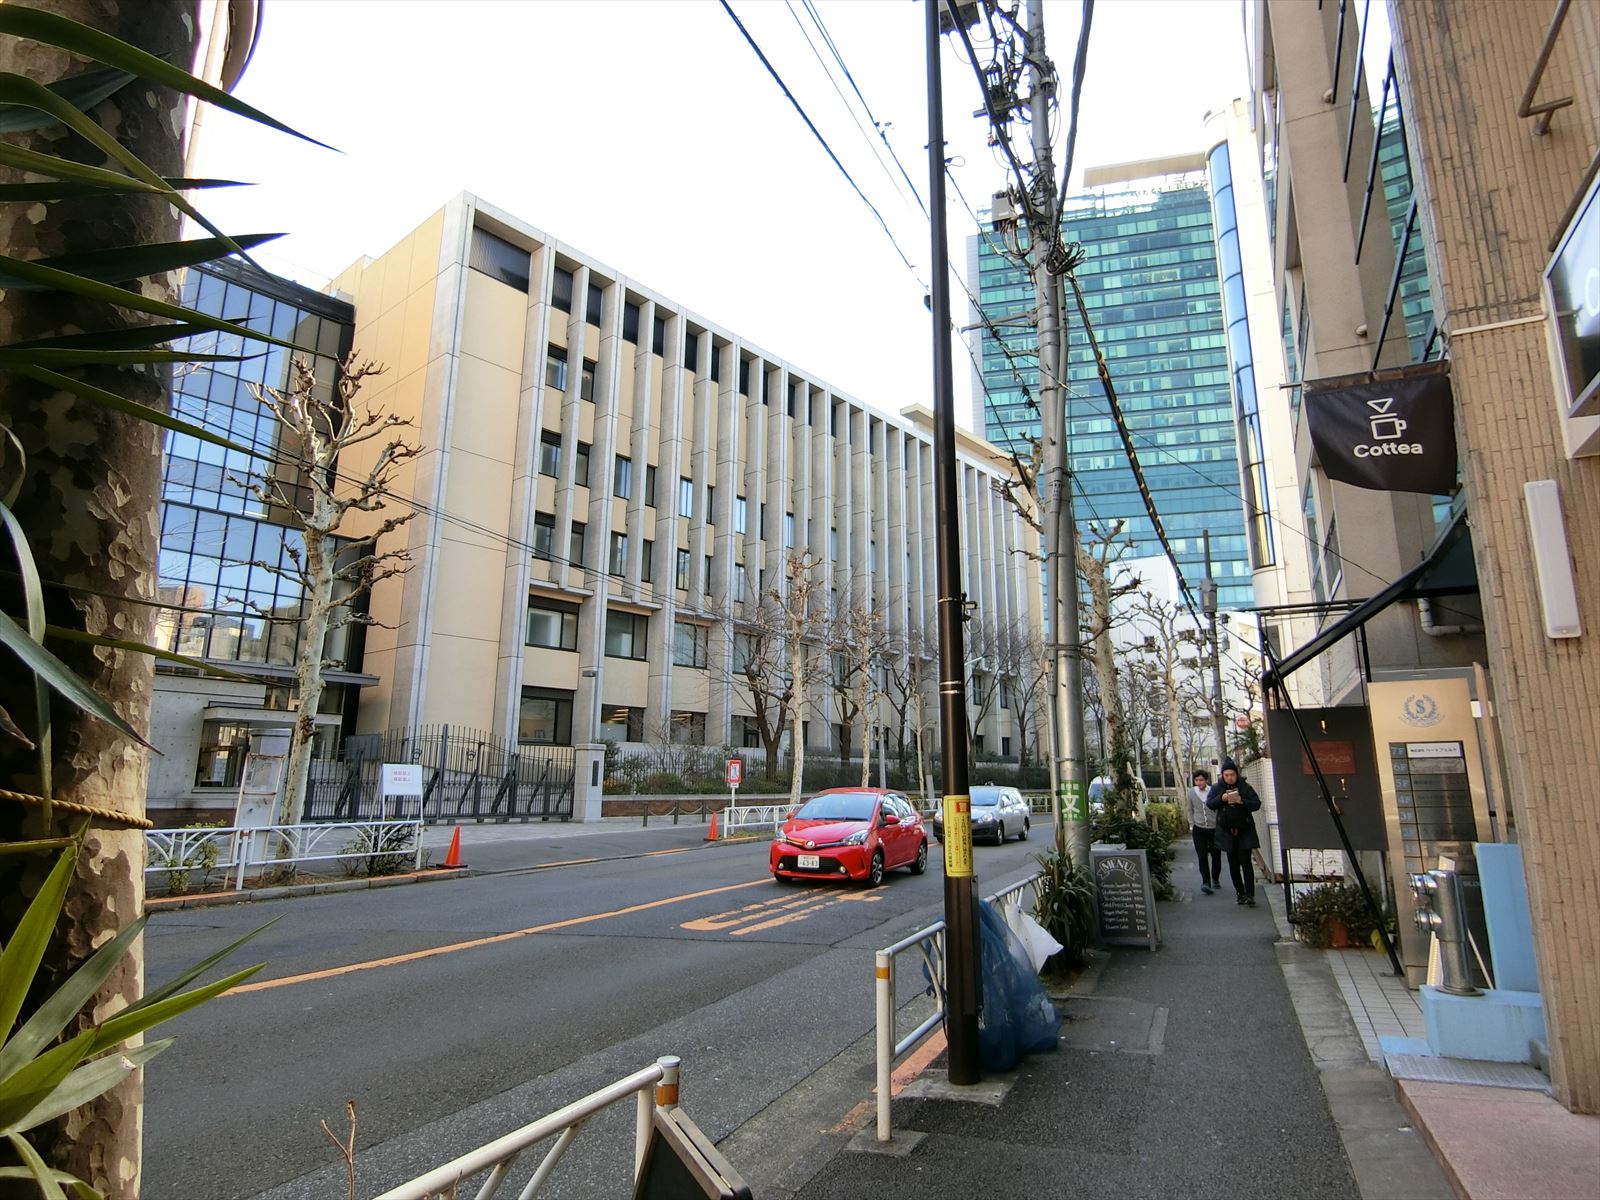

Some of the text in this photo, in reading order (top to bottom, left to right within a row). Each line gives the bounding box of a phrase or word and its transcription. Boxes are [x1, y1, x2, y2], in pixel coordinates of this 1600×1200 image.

[1353, 442, 1423, 458] Cottea
[1061, 791, 1080, 813] 文
[1102, 859, 1133, 872] MENU
